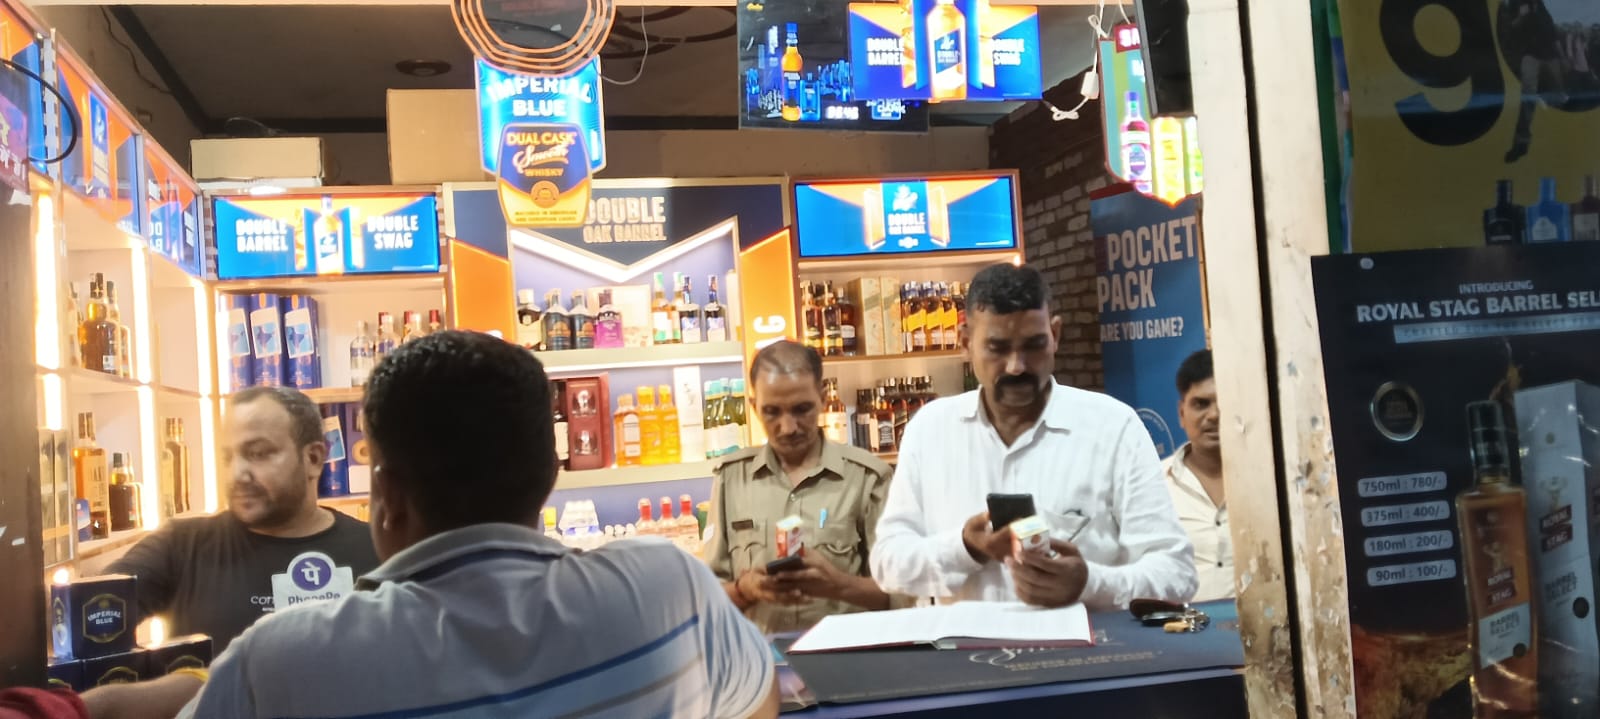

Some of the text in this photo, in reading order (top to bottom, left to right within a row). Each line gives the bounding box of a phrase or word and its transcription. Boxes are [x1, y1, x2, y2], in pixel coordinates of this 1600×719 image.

[486, 76, 592, 103] IMPERIAL
[512, 99, 567, 117] BLUE
[506, 131, 577, 146] DUAL CASK
[235, 218, 288, 235] DOUBLE
[367, 215, 419, 232] DOUBLE
[888, 212, 926, 226] DOUBLE
[373, 232, 413, 249] SWAG
[583, 224, 667, 243] OAK BARREL
[236, 235, 289, 253] BARREL
[1107, 216, 1196, 271] POCKET
[1096, 268, 1156, 313] PACK
[1458, 280, 1534, 295] INTRODUCING
[1357, 302, 1425, 323] ROYAL
[1428, 298, 1480, 318] STAG
[1486, 292, 1563, 314] BARREL
[1100, 316, 1184, 343] ARE YOU GAME?
[1363, 479, 1400, 493] 750ml
[1366, 508, 1402, 523] 375ml
[1412, 504, 1446, 518] 400/-
[1369, 537, 1406, 552] 180ml
[1416, 534, 1449, 547] 200/-
[1375, 566, 1405, 582] 90ml
[1418, 563, 1449, 578] 100/-
[87, 610, 120, 622] IMPERIAL
[96, 617, 113, 625] BLUE
